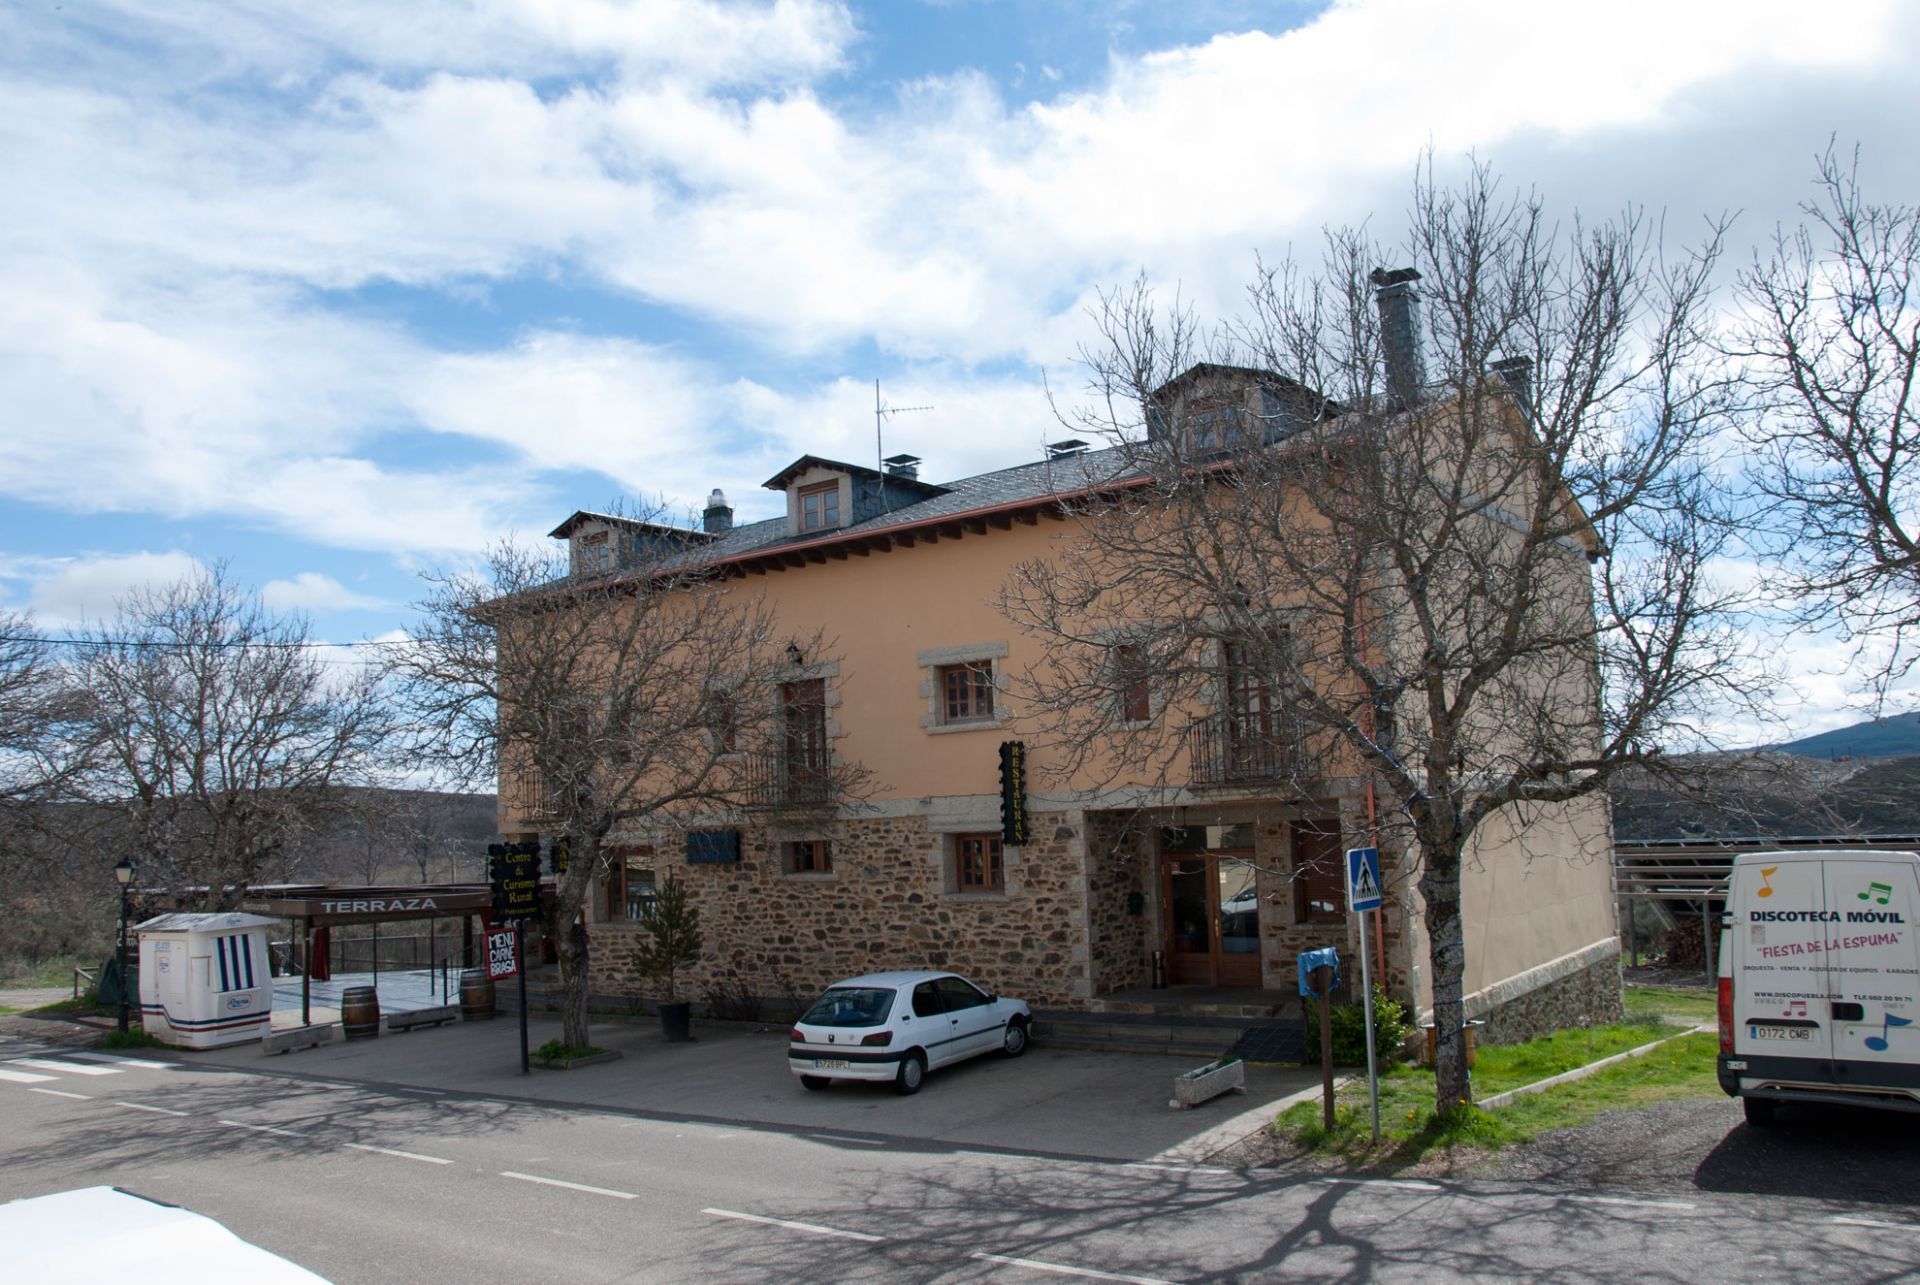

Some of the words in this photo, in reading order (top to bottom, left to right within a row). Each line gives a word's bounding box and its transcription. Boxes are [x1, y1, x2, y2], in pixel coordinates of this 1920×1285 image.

[505, 853, 532, 864] Centro
[509, 891, 533, 904] Rural
[321, 898, 437, 913] TERRAZA
[1750, 911, 1841, 923] DISCOTECA
[1847, 908, 1905, 924] MÓVIL
[1756, 943, 1804, 959] "FIESTA
[1806, 941, 1823, 953] DE
[1825, 938, 1840, 951] LA
[1843, 931, 1903, 950] ESPUMA"
[489, 945, 515, 963] CARNE
[490, 960, 517, 976] BRASA
[1758, 1028, 1785, 1039] 0172
[1788, 1029, 1810, 1040] CMB
